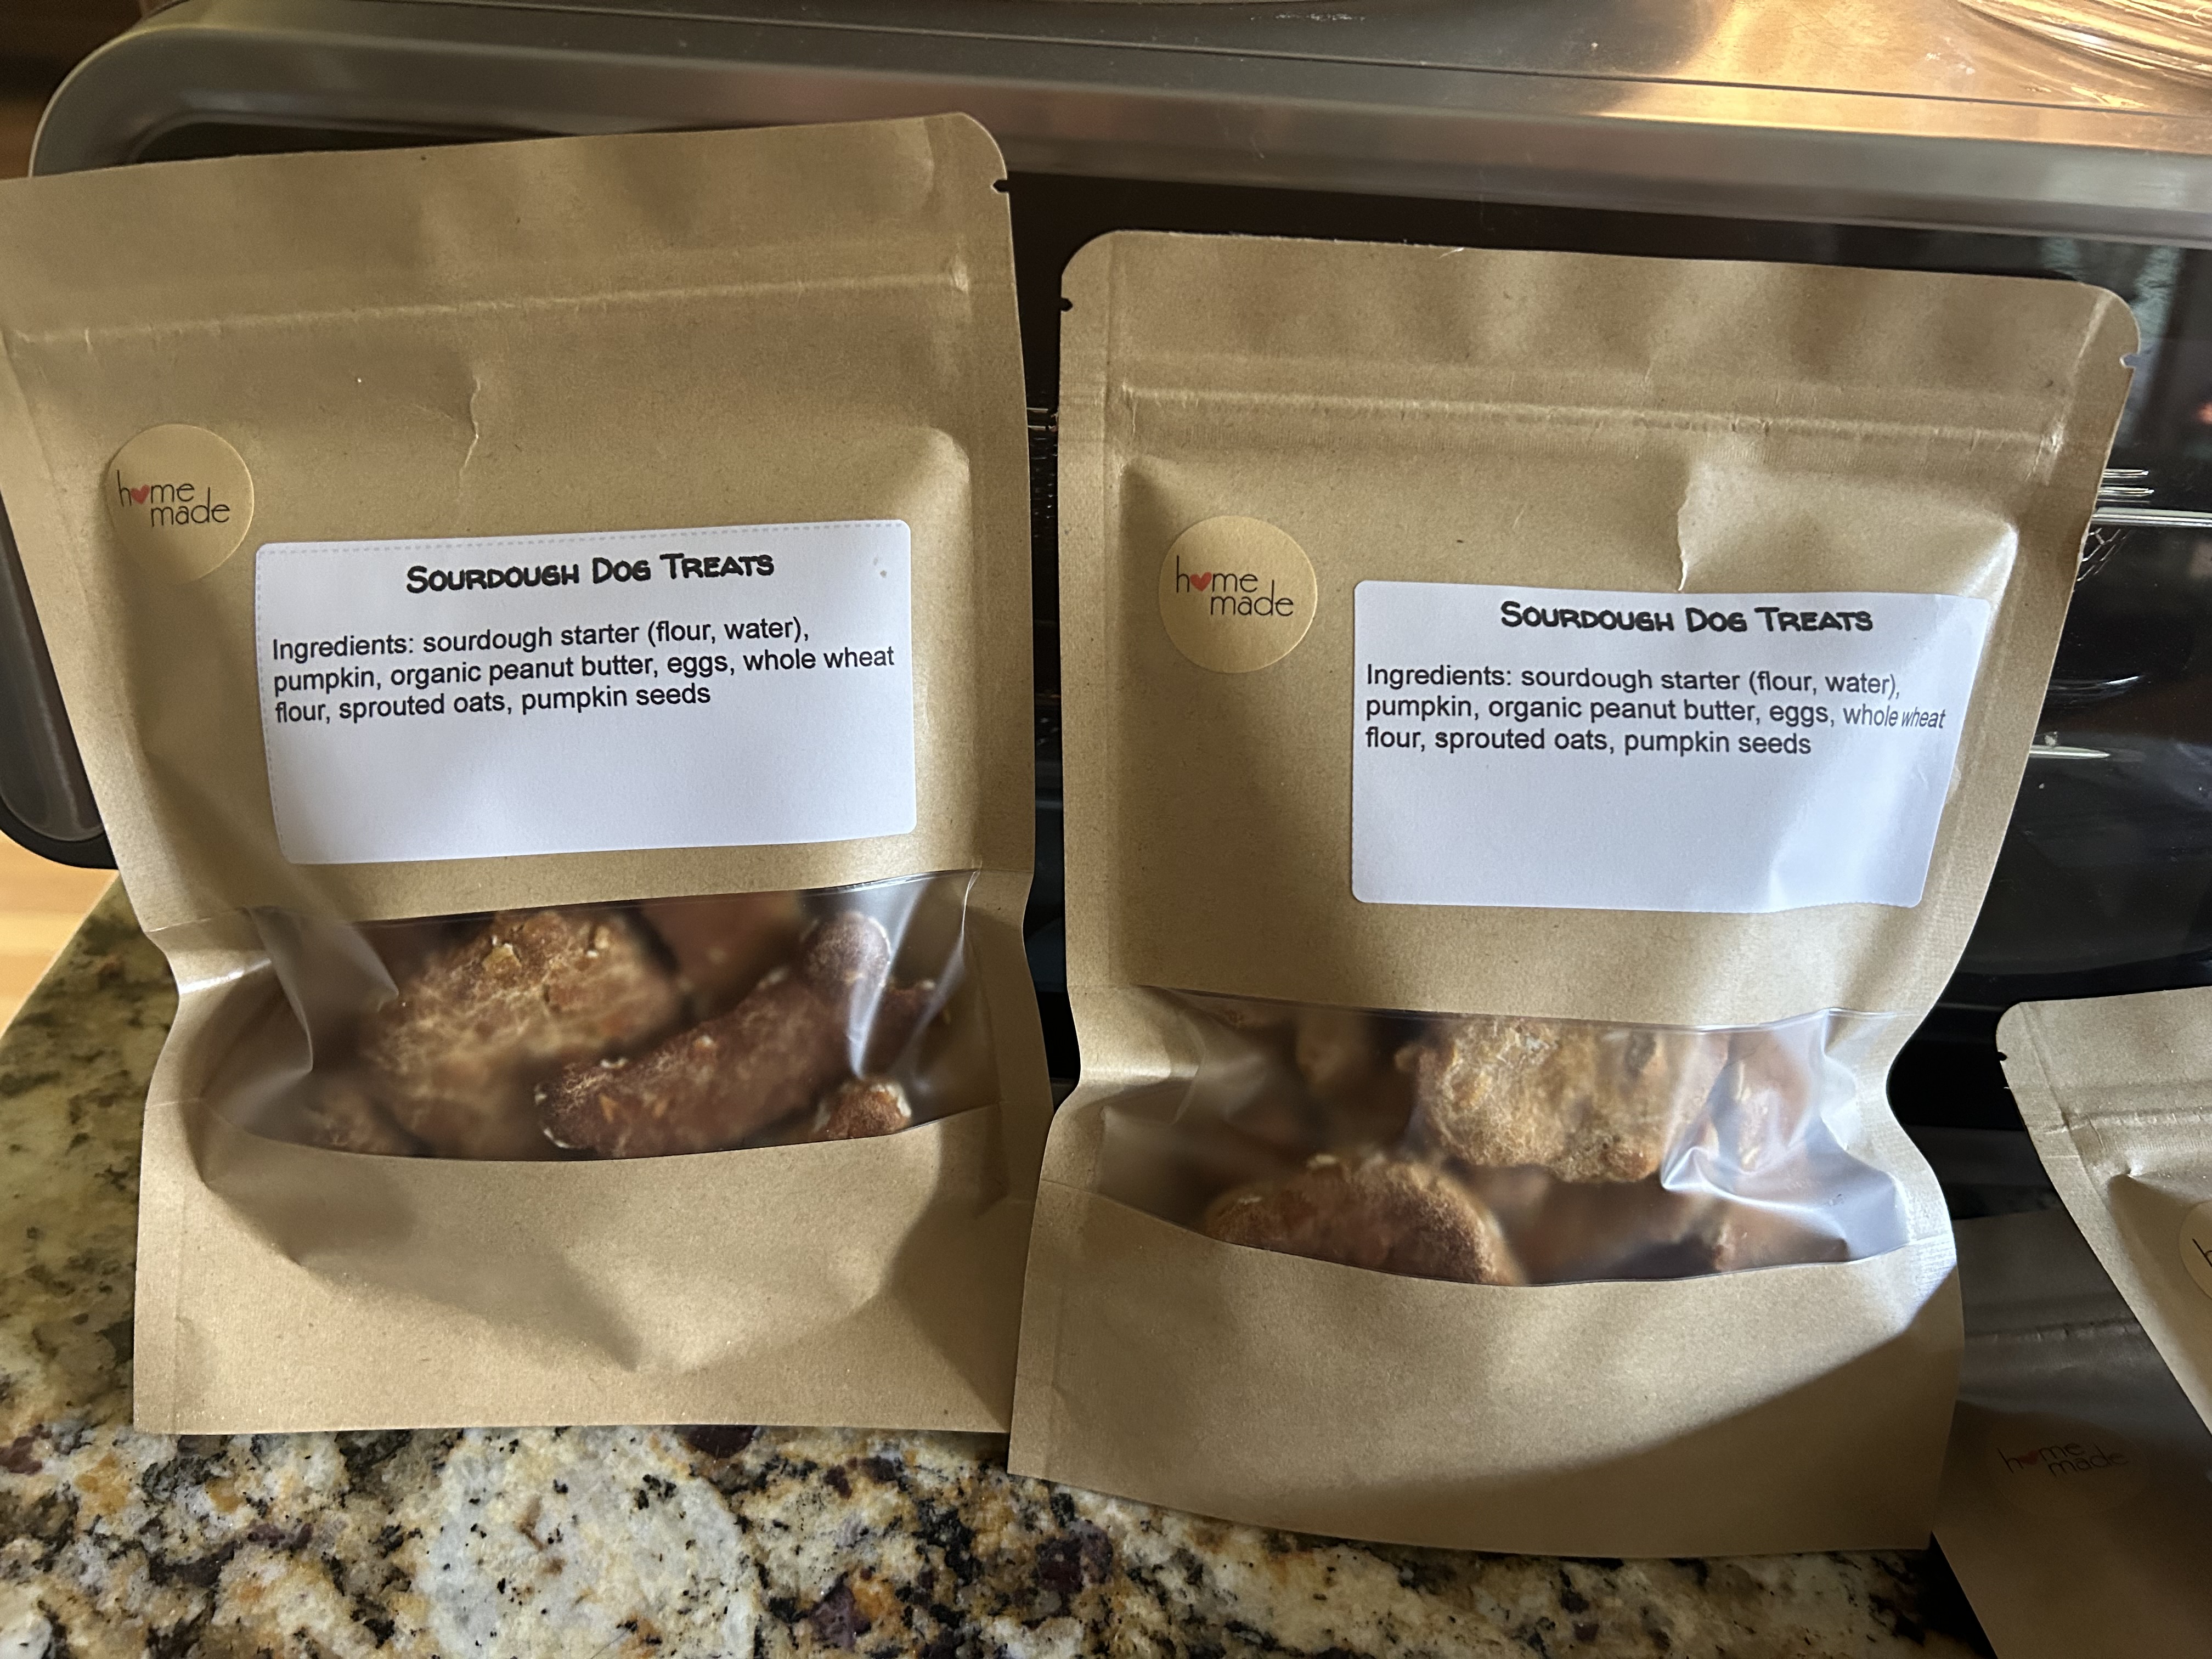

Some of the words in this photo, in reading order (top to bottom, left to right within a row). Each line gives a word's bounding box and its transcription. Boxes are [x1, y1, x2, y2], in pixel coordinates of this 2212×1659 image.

[151, 486, 230, 527] made
[1211, 579, 1294, 617] made
[274, 635, 413, 664] Ingredients:
[424, 627, 552, 652] sourdough
[561, 624, 639, 645] starter
[648, 620, 715, 647] (flour,
[724, 617, 808, 643] water),
[275, 667, 381, 697] pumpkin,
[391, 662, 481, 690] organic
[490, 657, 573, 686] peanut
[582, 655, 657, 678] butter,
[668, 656, 734, 678] eggs,
[743, 648, 816, 670] whole
[823, 646, 894, 668] wheat
[1368, 664, 1510, 690] Ingredients:
[1522, 668, 1652, 693] sourdough
[1661, 672, 1740, 690] starter
[1750, 671, 1816, 695] (flour,
[1825, 673, 1899, 699] water),
[275, 702, 330, 724] flour,
[340, 693, 444, 724] sprouted
[454, 692, 511, 714] oats,
[522, 685, 627, 715] pumpkin
[636, 682, 710, 706] seeds
[1367, 696, 1479, 721] pumpkin,
[1489, 697, 1582, 722] organic
[1591, 700, 1676, 723] peanut
[1684, 699, 1759, 725] butter,
[1770, 706, 1834, 727] eggs,
[1843, 704, 1898, 726] whole
[1901, 707, 1945, 729] wheat
[1365, 726, 1425, 752] flour,
[1435, 728, 1544, 753] sprouted
[1555, 730, 1613, 754] oats,
[1625, 731, 1729, 757] pumpkin
[1739, 733, 1811, 754] seeds
[2047, 1443, 2129, 1477] made
